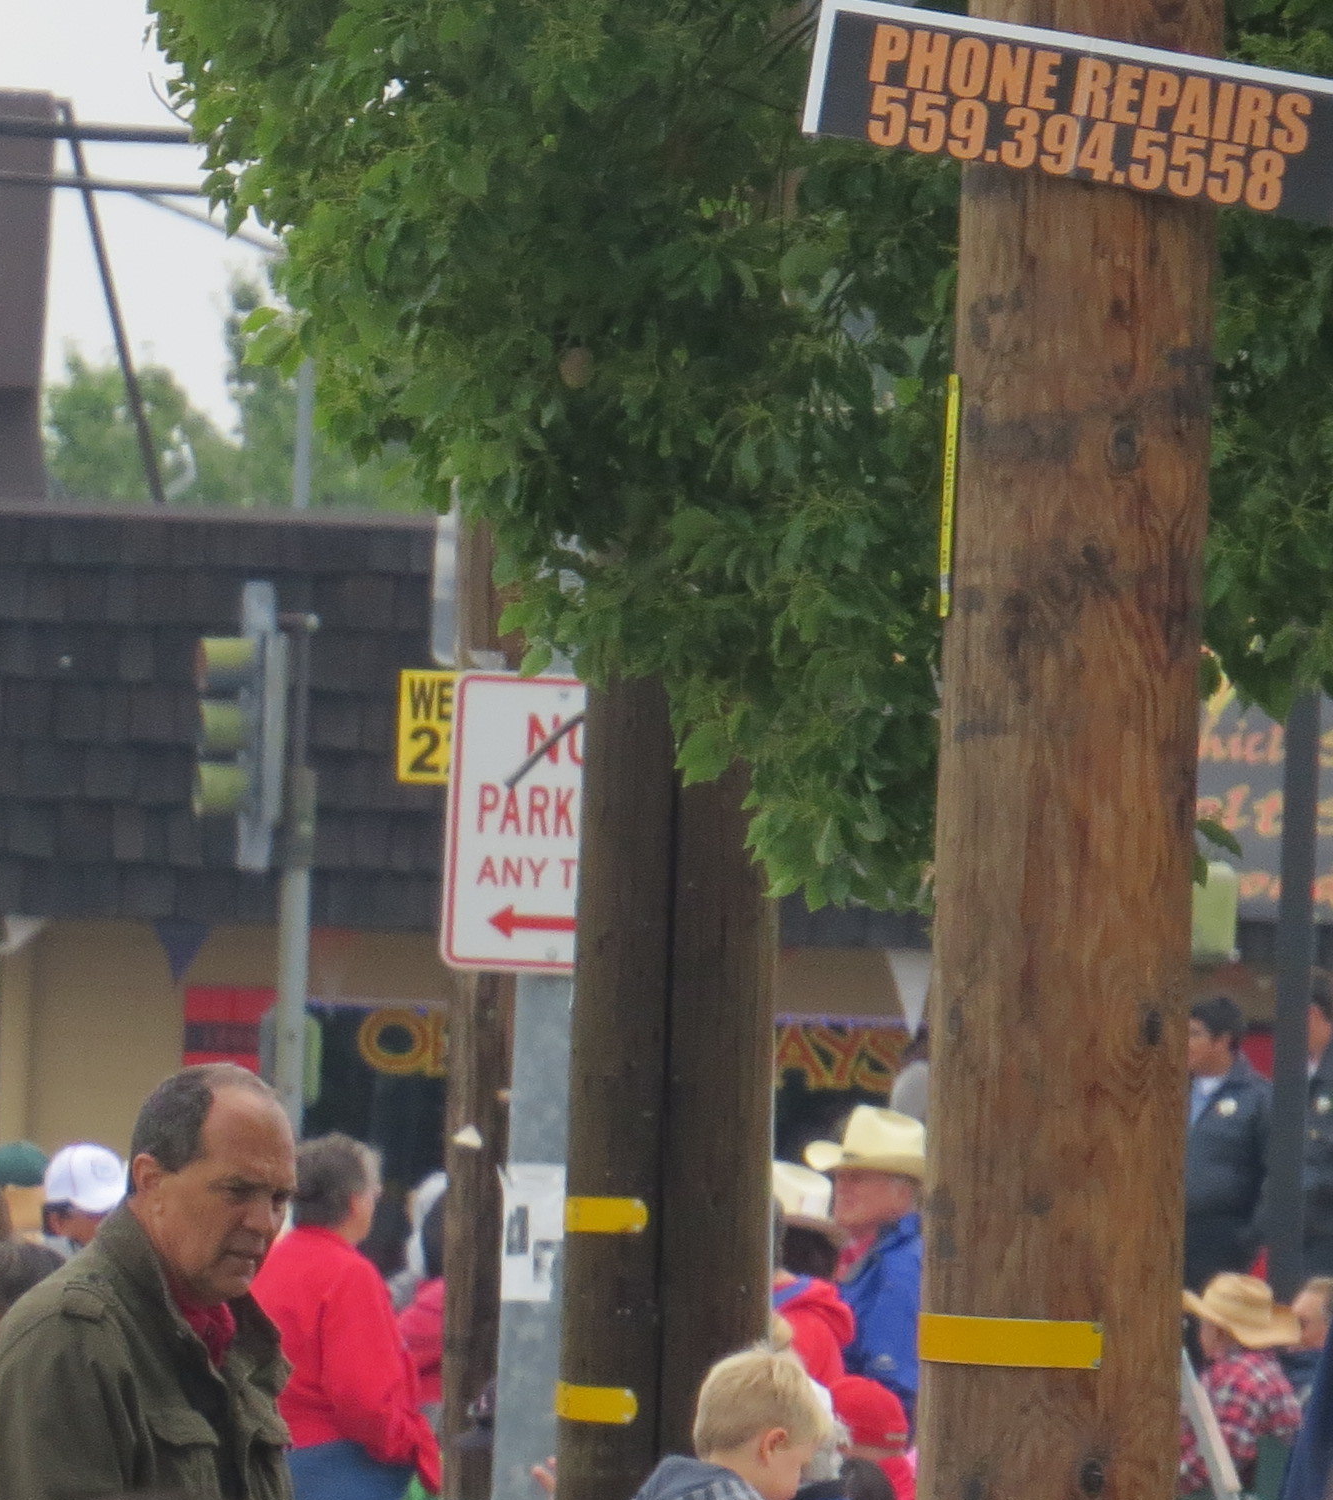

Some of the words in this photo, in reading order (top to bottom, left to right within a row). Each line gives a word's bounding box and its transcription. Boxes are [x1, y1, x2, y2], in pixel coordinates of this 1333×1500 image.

[867, 23, 1062, 110] PHONE
[1071, 57, 1314, 155] REPAIRS
[866, 84, 1286, 211] 559.394.5558
[408, 727, 453, 774] 2
[476, 855, 549, 888] ANY
